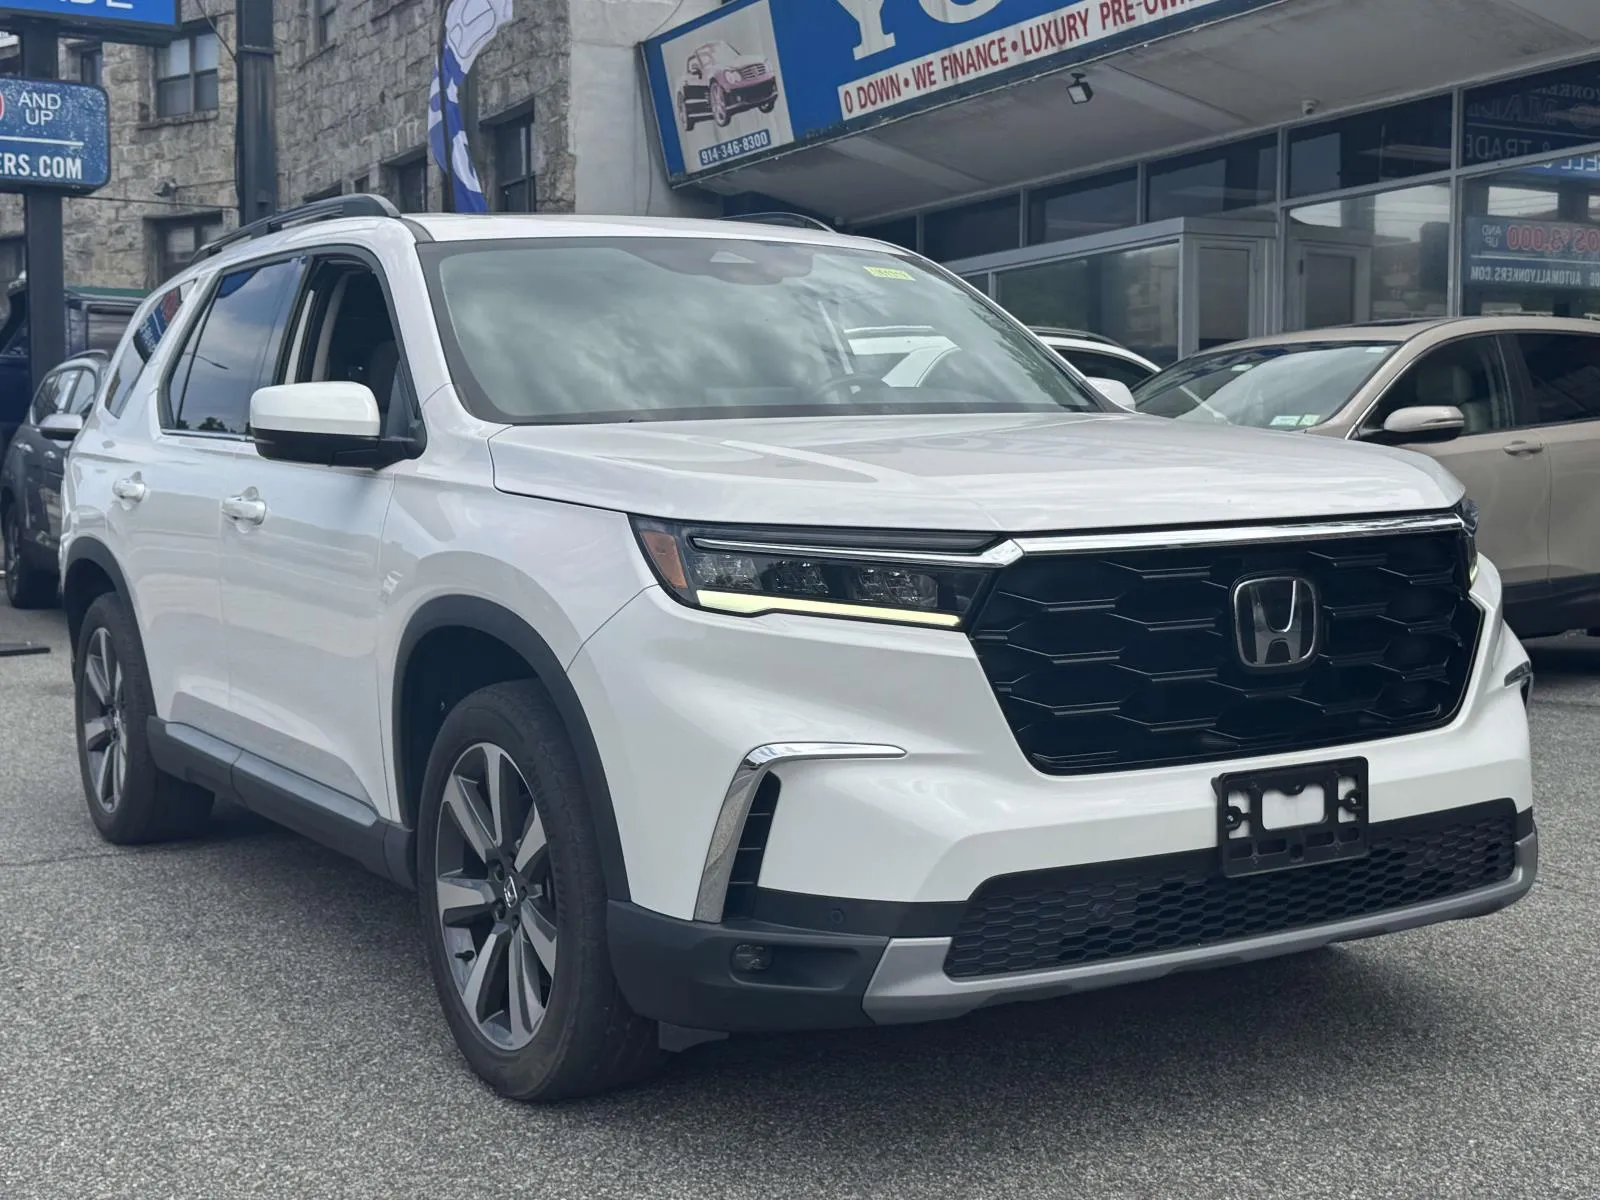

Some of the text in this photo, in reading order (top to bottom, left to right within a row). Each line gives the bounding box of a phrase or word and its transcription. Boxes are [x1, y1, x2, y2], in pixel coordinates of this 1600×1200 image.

[857, 73, 901, 109] DOWN
[912, 60, 936, 91] WE
[940, 37, 1008, 82] FINANCE
[1020, 8, 1089, 56] LUXURY
[18, 91, 62, 110] AND
[25, 108, 53, 126] UP
[701, 131, 768, 165] 914-346-8300
[0, 152, 82, 180] RS.COM
